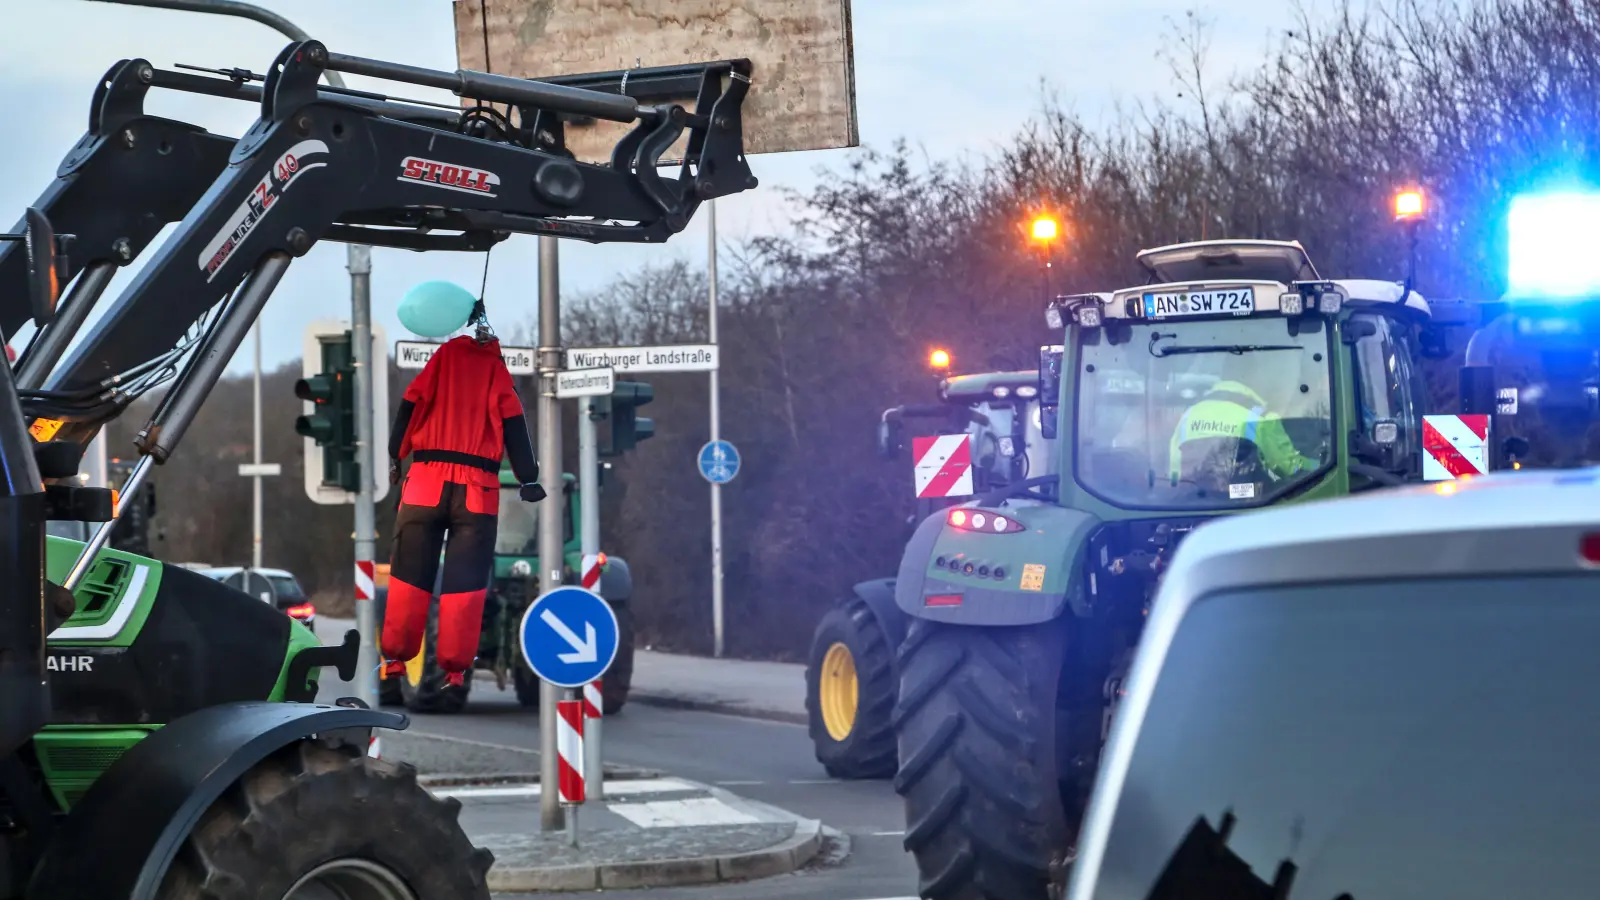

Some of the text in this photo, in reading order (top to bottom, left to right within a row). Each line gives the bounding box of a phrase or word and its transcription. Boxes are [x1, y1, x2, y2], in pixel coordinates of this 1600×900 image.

[403, 159, 491, 192] STOLL
[246, 183, 275, 220] FZ
[278, 154, 298, 181] 40
[1156, 292, 1251, 313] AN SW 724
[573, 349, 712, 369] Würzburger Landstraße
[1191, 420, 1238, 433] Winkler
[46, 655, 94, 672] AHR
